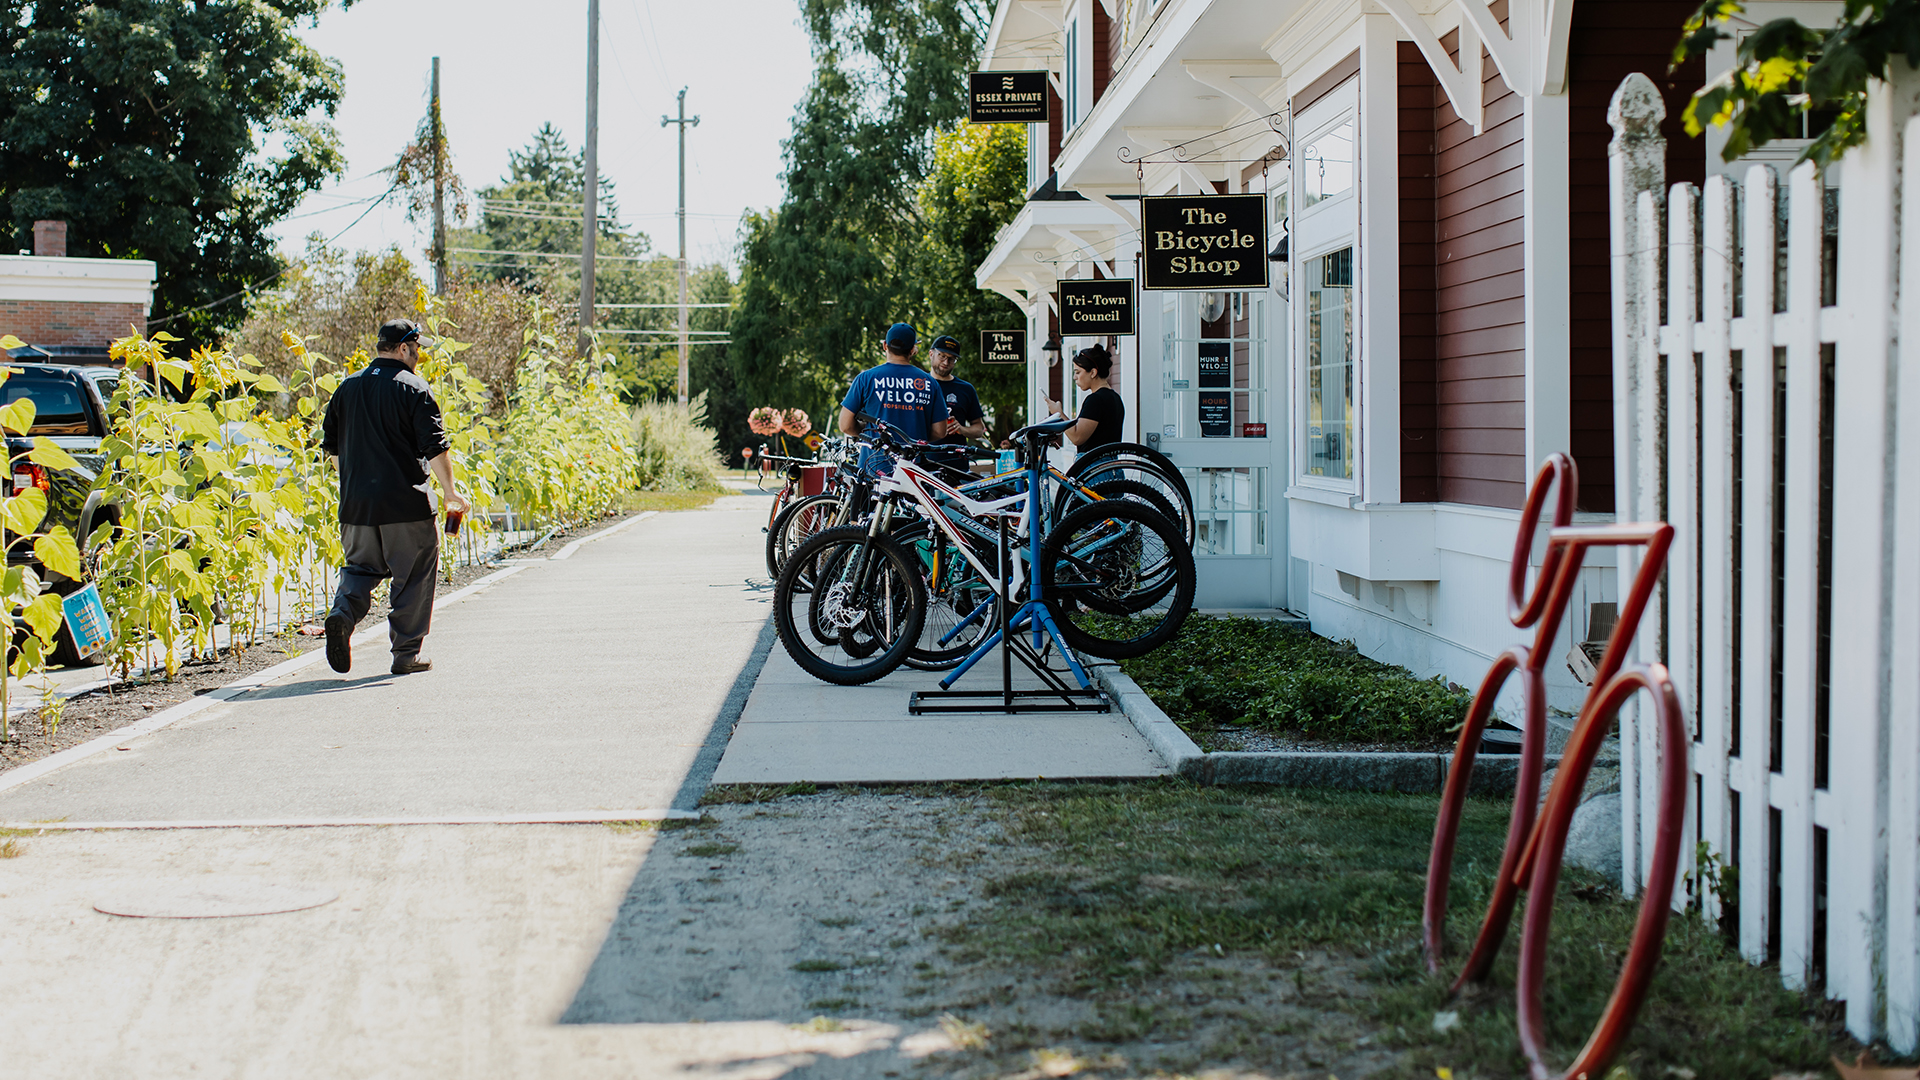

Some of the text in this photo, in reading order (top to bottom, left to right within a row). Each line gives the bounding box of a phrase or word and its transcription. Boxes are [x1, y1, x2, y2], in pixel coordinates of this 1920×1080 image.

[975, 92, 1042, 102] ESSEX PRIVATE
[1181, 207, 1227, 225] The
[1154, 228, 1255, 253] Bicycle
[1170, 256, 1241, 276] Shop
[1066, 294, 1126, 306] Tri-Town
[1072, 309, 1120, 322] Council
[992, 333, 1013, 342] The
[993, 342, 1013, 351] Art
[988, 351, 1020, 361] Room
[874, 377, 931, 391] MUNROE
[875, 390, 915, 403] VELO
